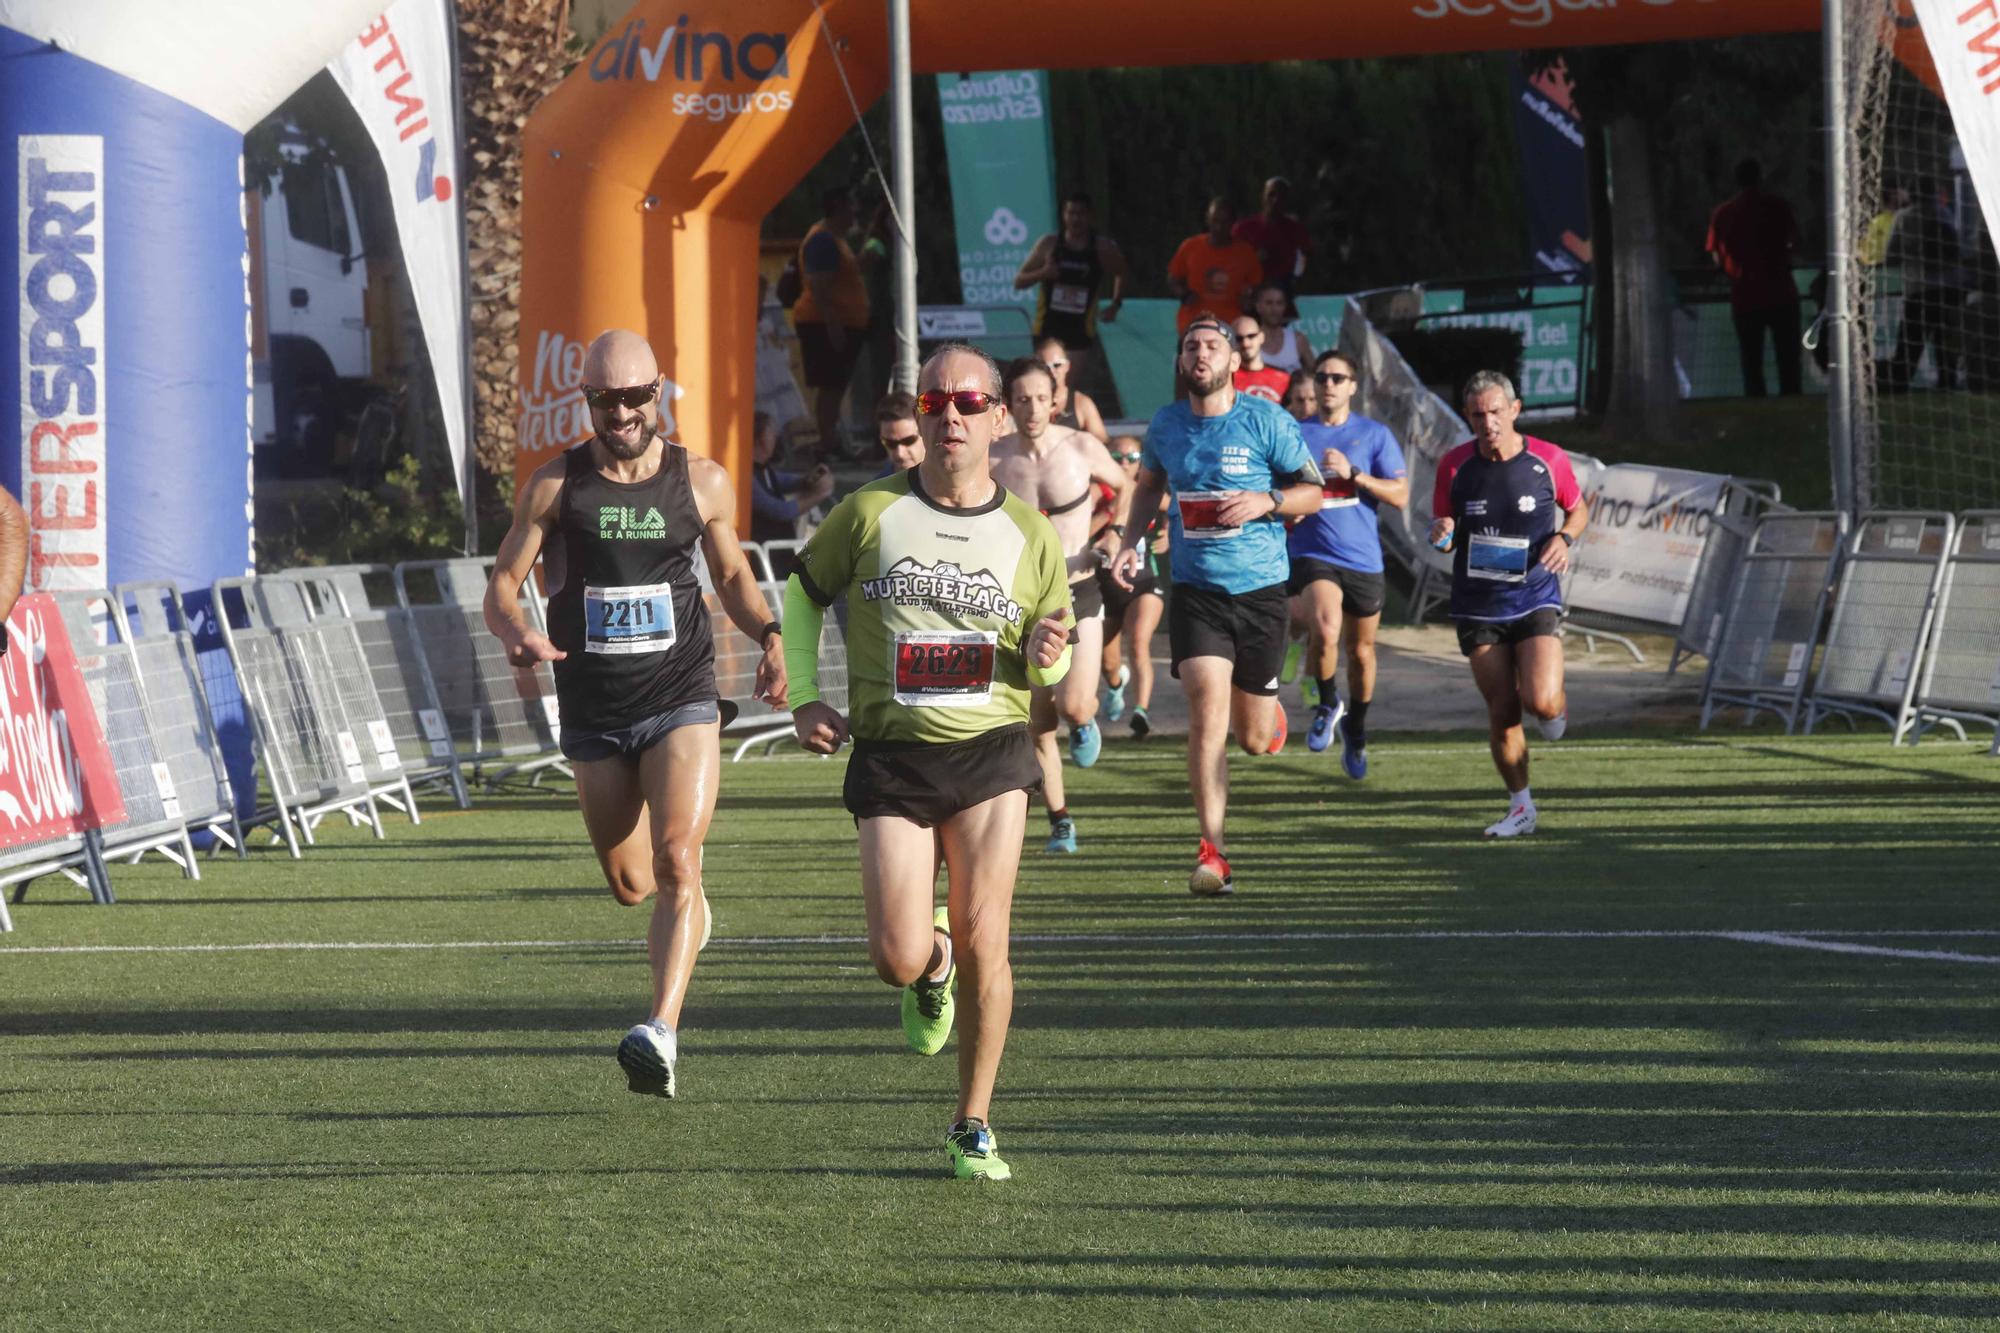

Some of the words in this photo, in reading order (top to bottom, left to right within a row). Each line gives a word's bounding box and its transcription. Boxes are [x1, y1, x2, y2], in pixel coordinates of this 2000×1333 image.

[590, 14, 789, 82] divina
[672, 90, 793, 121] seguros
[1537, 321, 1568, 346] del
[27, 157, 100, 668] TERSPORT
[600, 506, 666, 530] FILA
[600, 530, 613, 539] BE
[616, 530, 624, 539] A
[626, 530, 666, 539] RUNNER
[601, 599, 654, 627] 2211
[894, 597, 920, 606] CLUB
[935, 601, 989, 619] ATLETISMO
[910, 645, 981, 675] 2629
